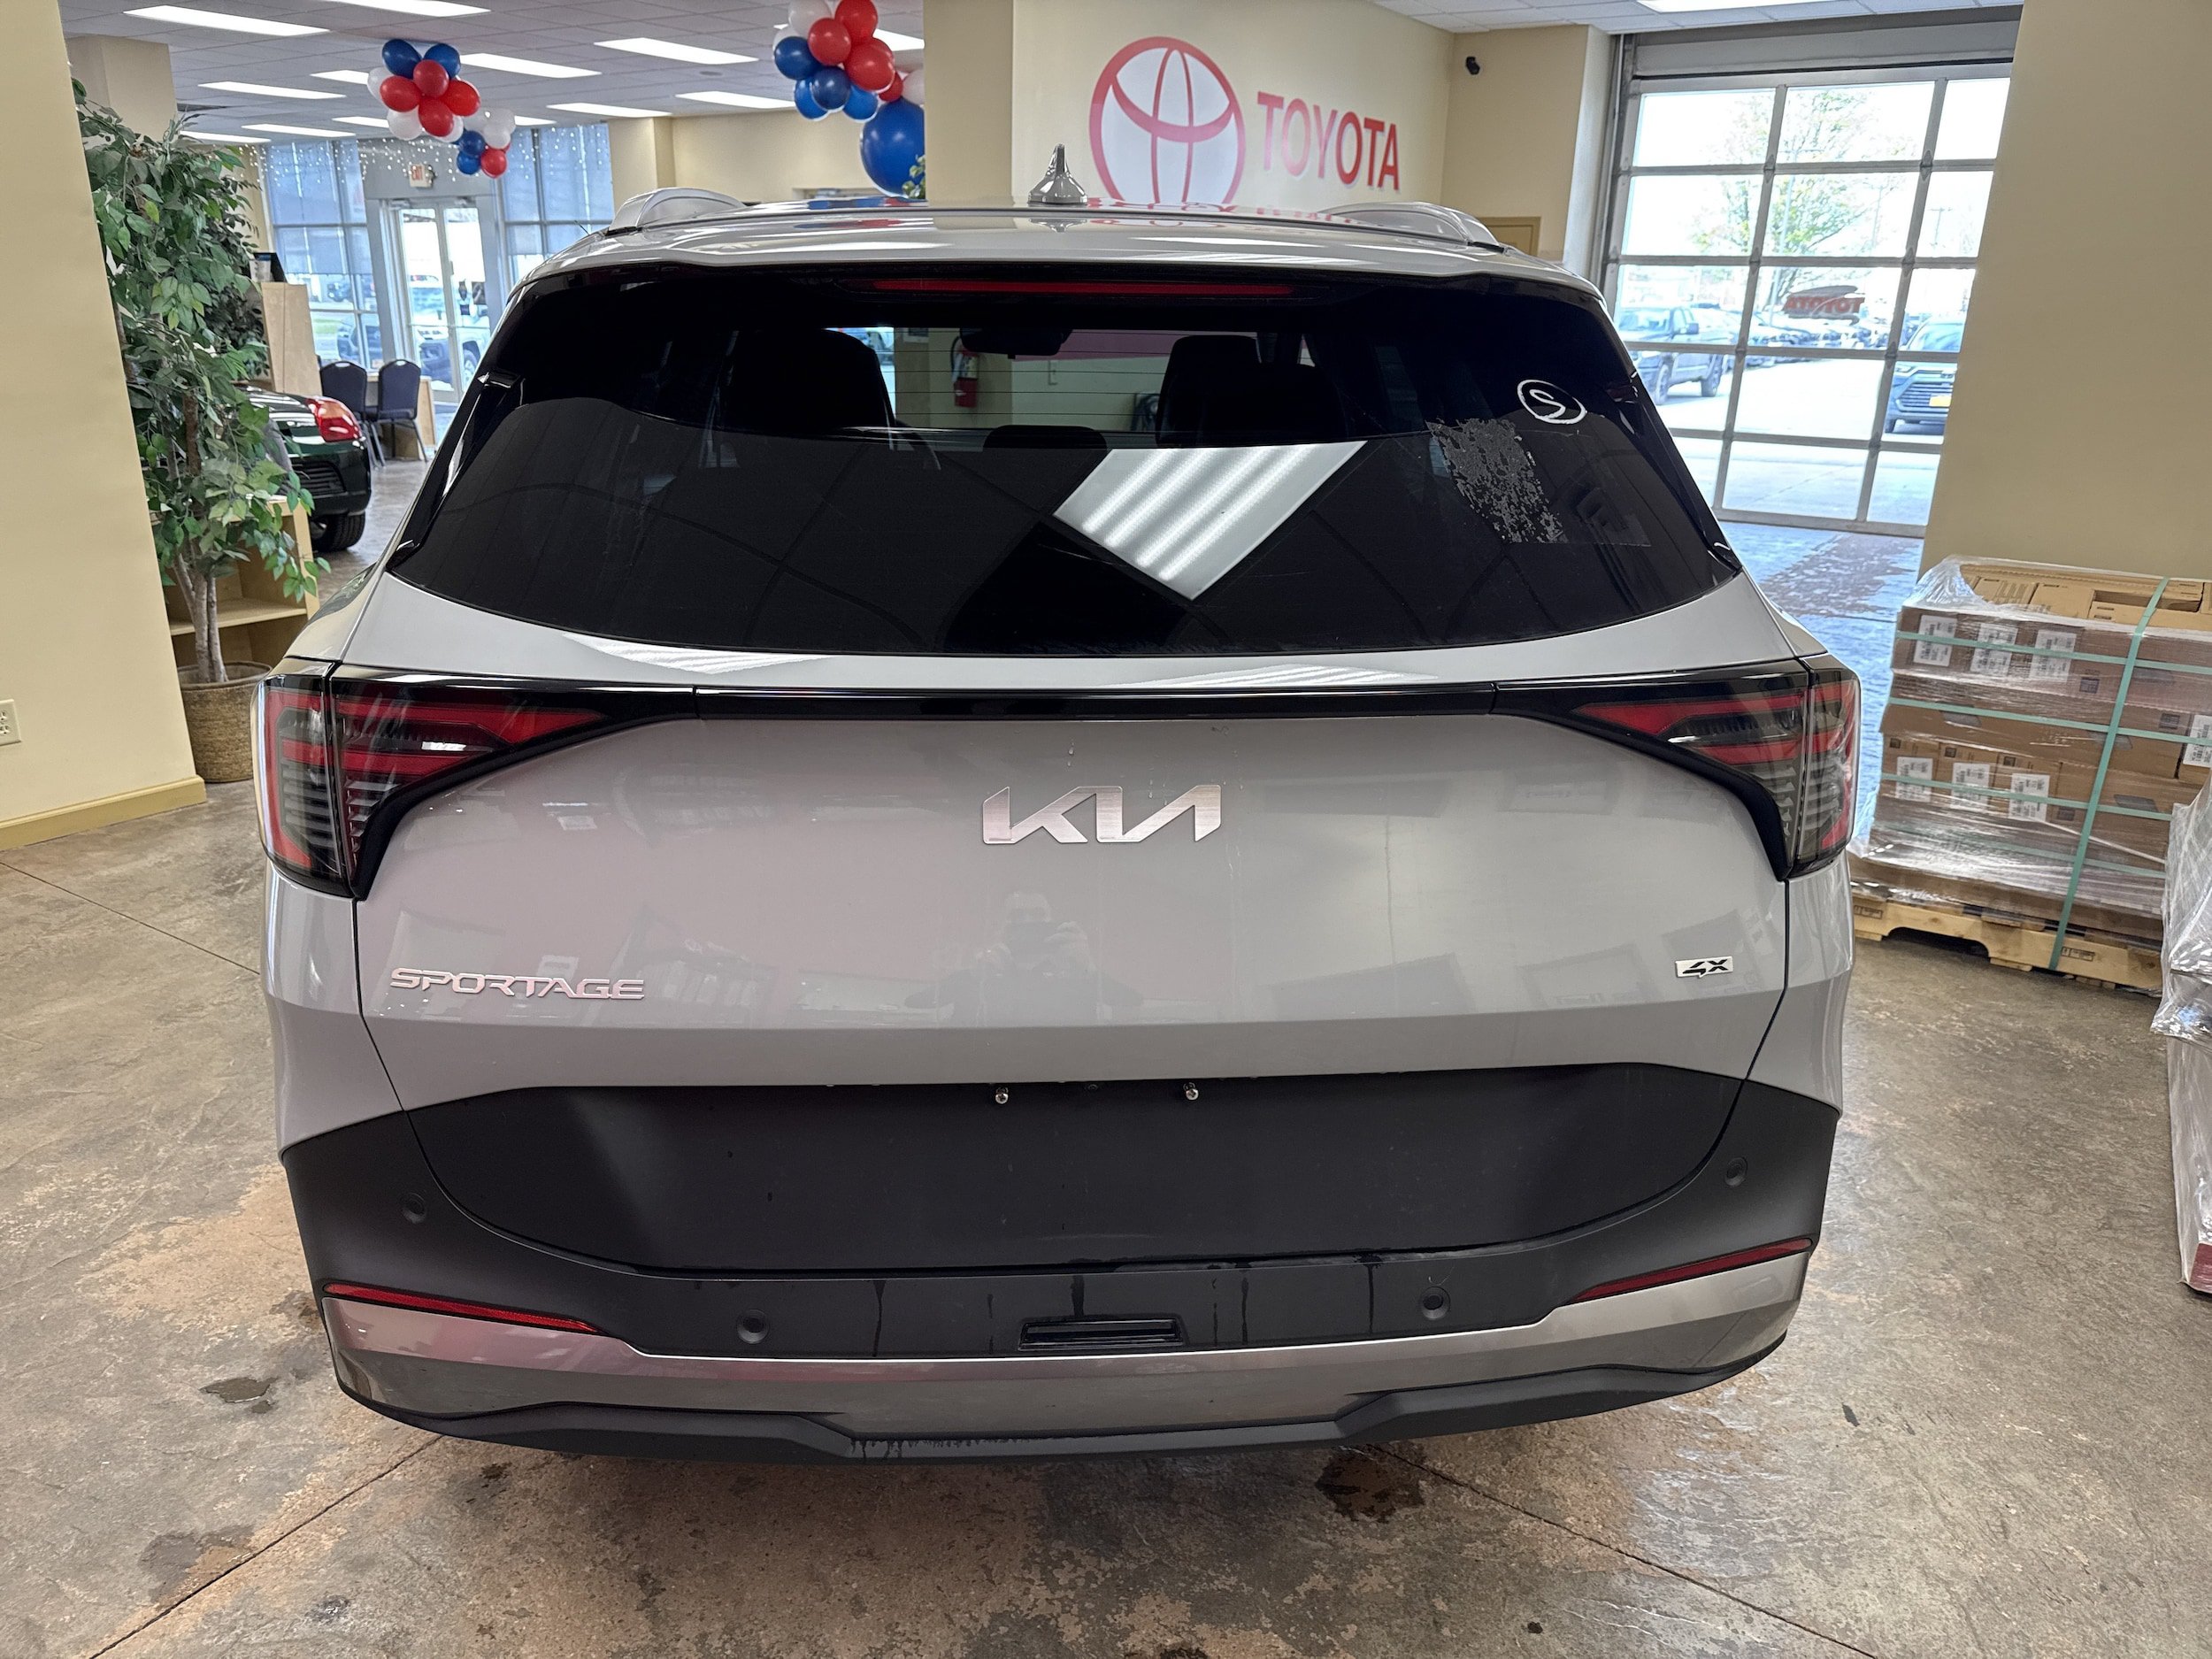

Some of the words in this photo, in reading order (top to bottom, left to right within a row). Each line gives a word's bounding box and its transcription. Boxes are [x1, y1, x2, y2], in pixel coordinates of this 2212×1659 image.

[1256, 91, 1399, 190] TOYOTA
[982, 784, 1221, 844] KIA
[389, 967, 645, 1000] SPORTAGE
